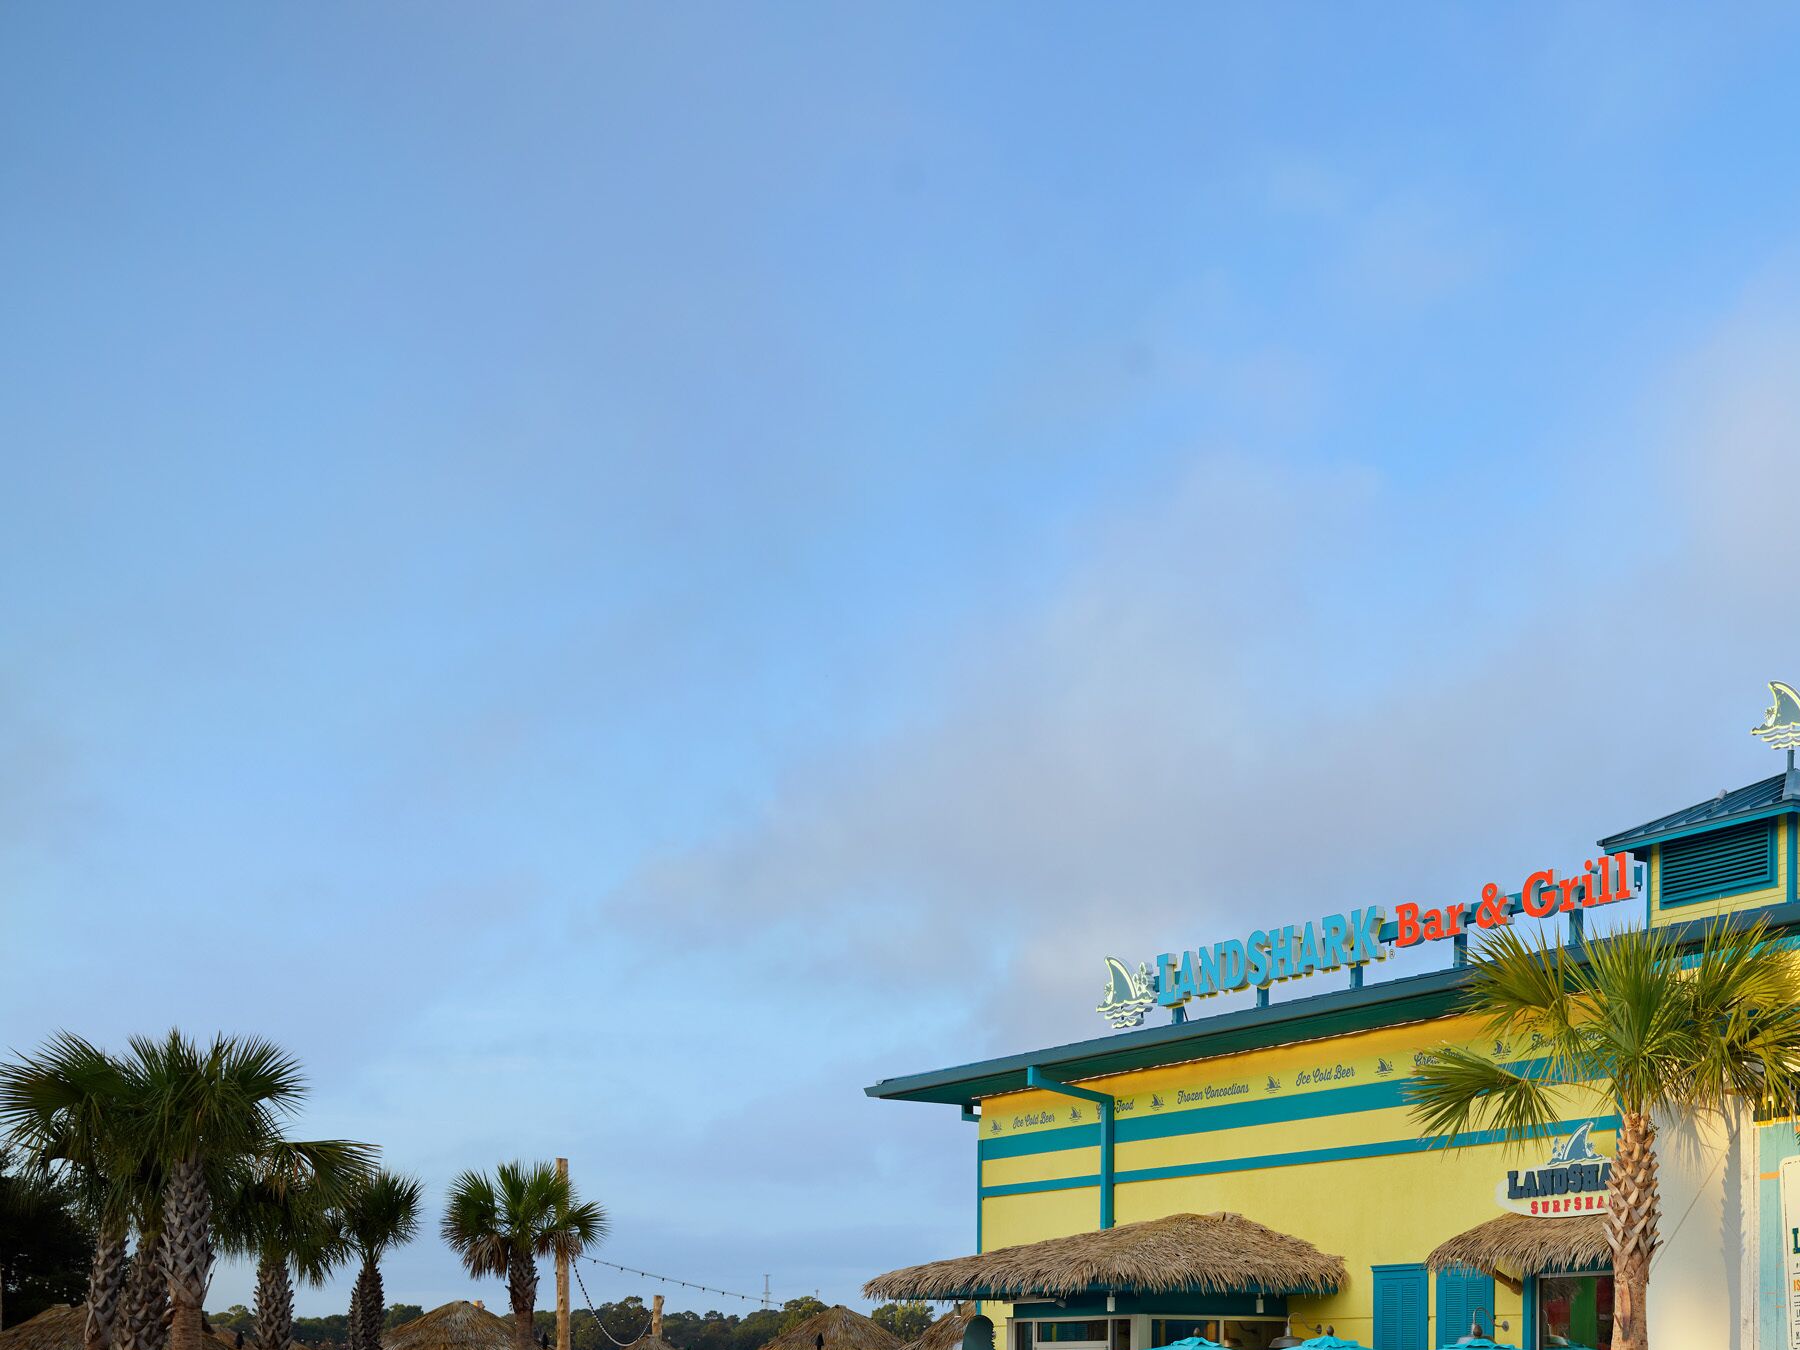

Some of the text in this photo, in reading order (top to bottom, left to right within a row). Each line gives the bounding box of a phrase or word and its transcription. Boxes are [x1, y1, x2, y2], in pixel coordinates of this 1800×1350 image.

[1157, 852, 1634, 1007] LANDSHARK Bar & Grill
[1295, 1064, 1355, 1087] Ice Cold Beer
[1177, 1083, 1249, 1104] Frozen Concoctions
[1115, 1099, 1135, 1114] Food
[1024, 1114, 1039, 1127] Cold
[1040, 1111, 1055, 1125] Beer
[1507, 1163, 1612, 1199] LANDSHA
